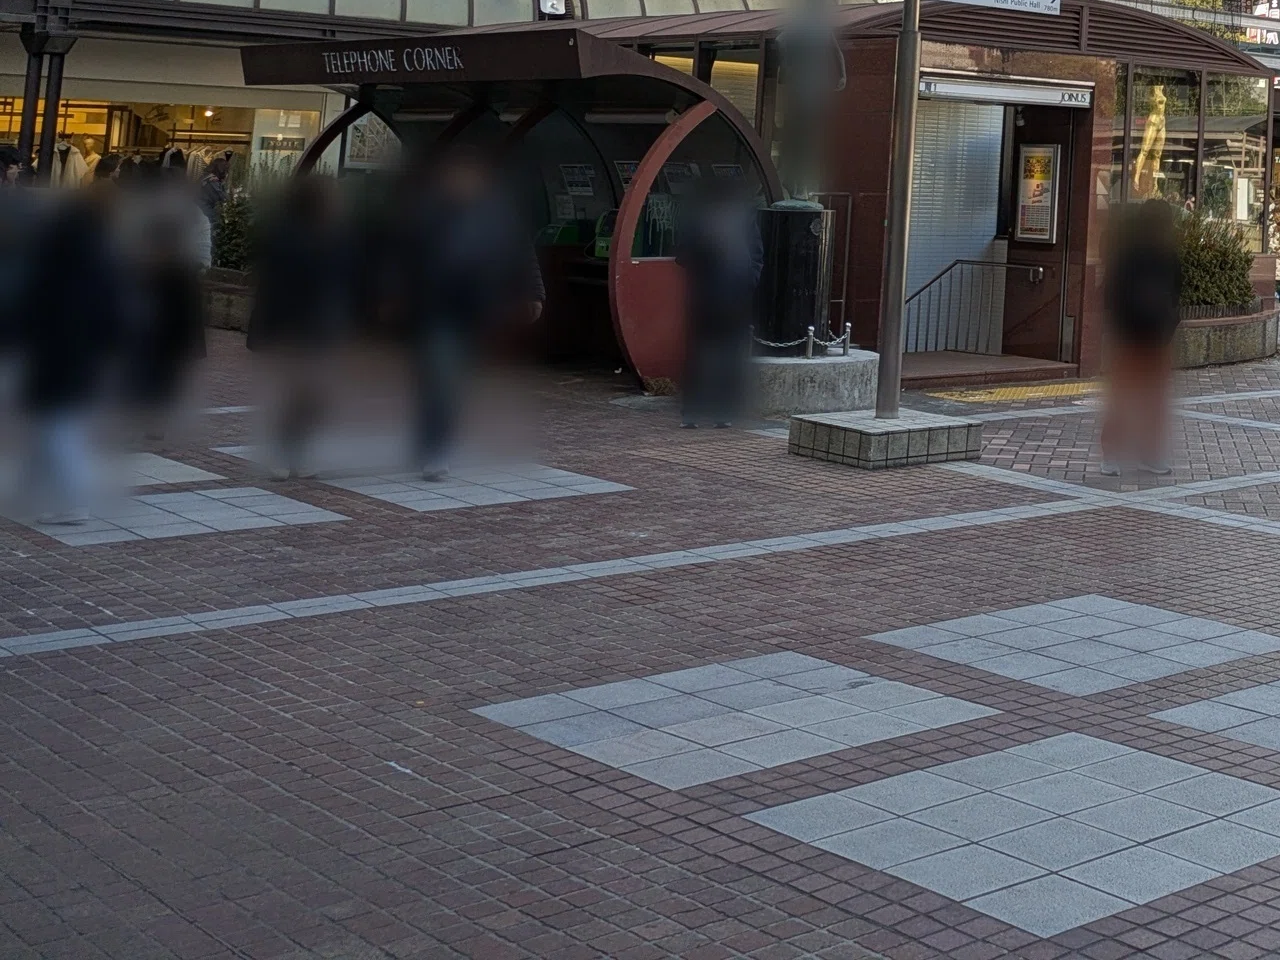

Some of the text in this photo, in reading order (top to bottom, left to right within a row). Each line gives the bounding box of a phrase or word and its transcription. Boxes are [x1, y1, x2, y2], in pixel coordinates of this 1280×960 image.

[1029, 0, 1041, 9] Hall
[321, 46, 465, 74] TELEPHONE CORNER
[1059, 91, 1088, 105] JOINUS
